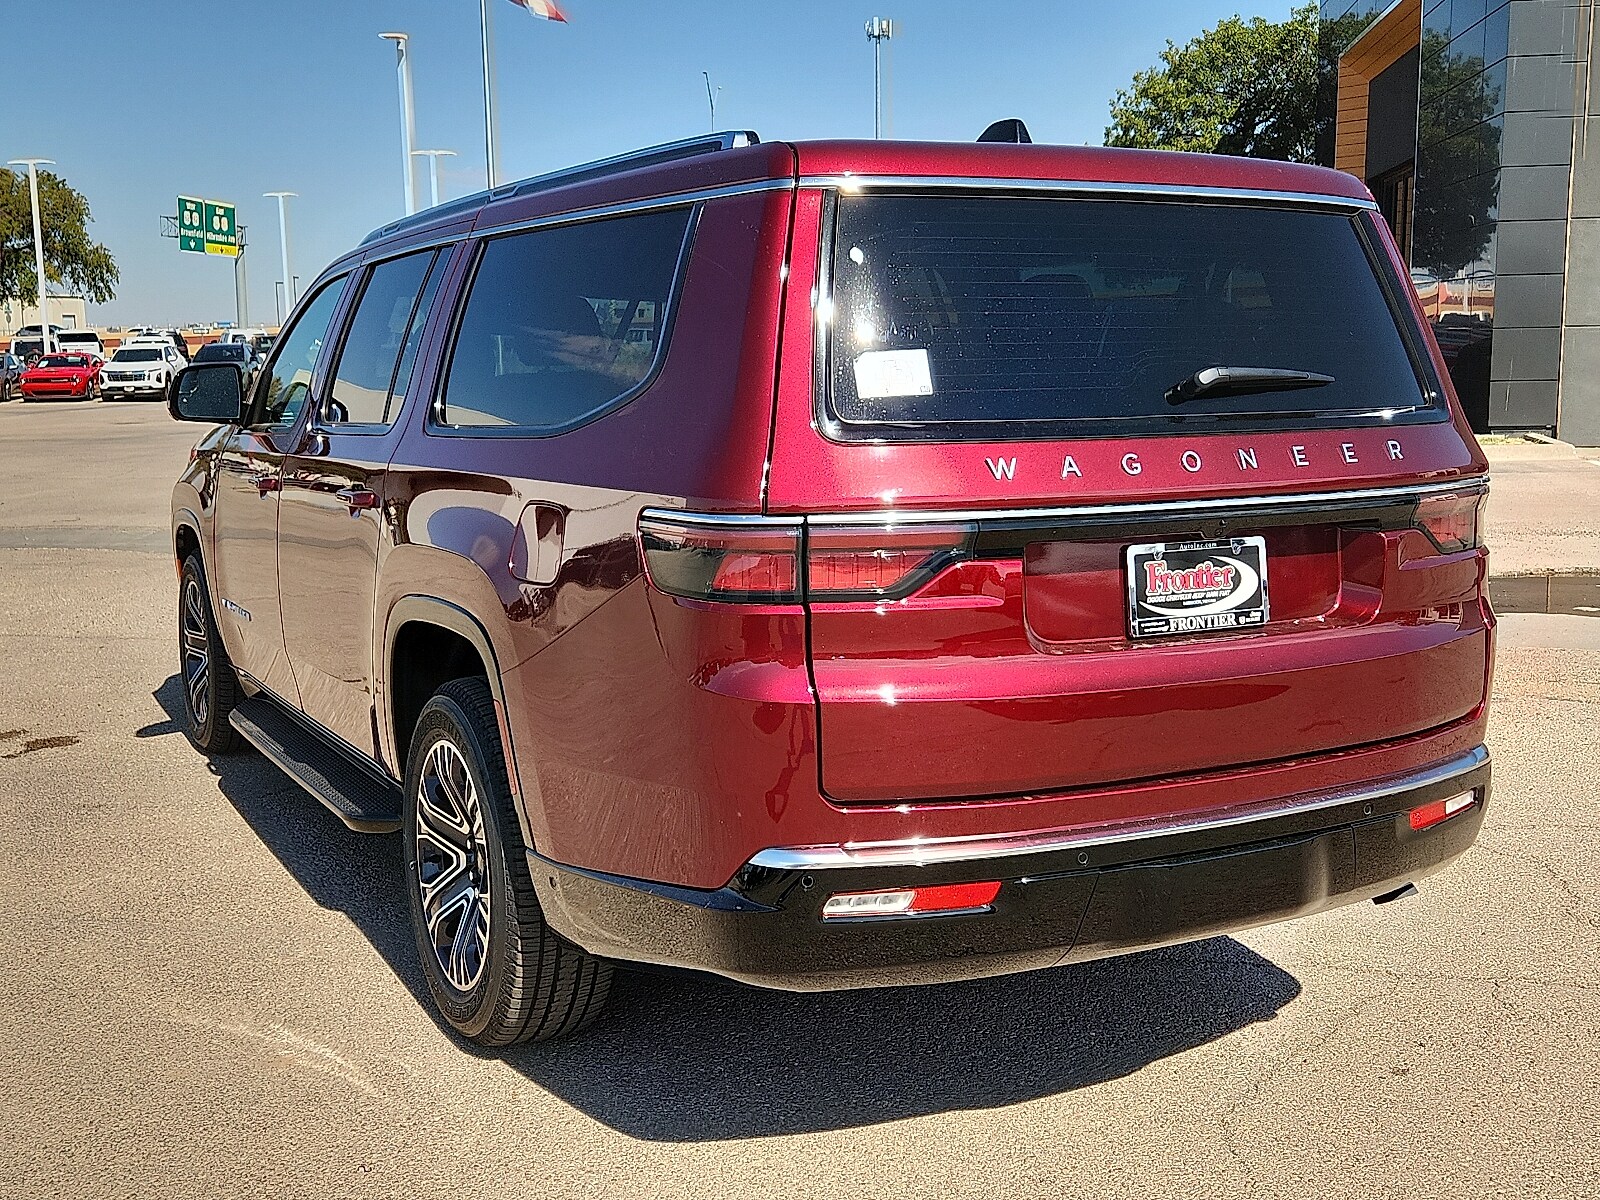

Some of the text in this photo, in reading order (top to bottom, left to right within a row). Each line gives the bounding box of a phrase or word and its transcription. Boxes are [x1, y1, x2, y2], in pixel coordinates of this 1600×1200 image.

[985, 439, 1405, 480] WAGONEER
[1145, 561, 1234, 594] Frontier
[1169, 613, 1237, 632] FRONTIER
